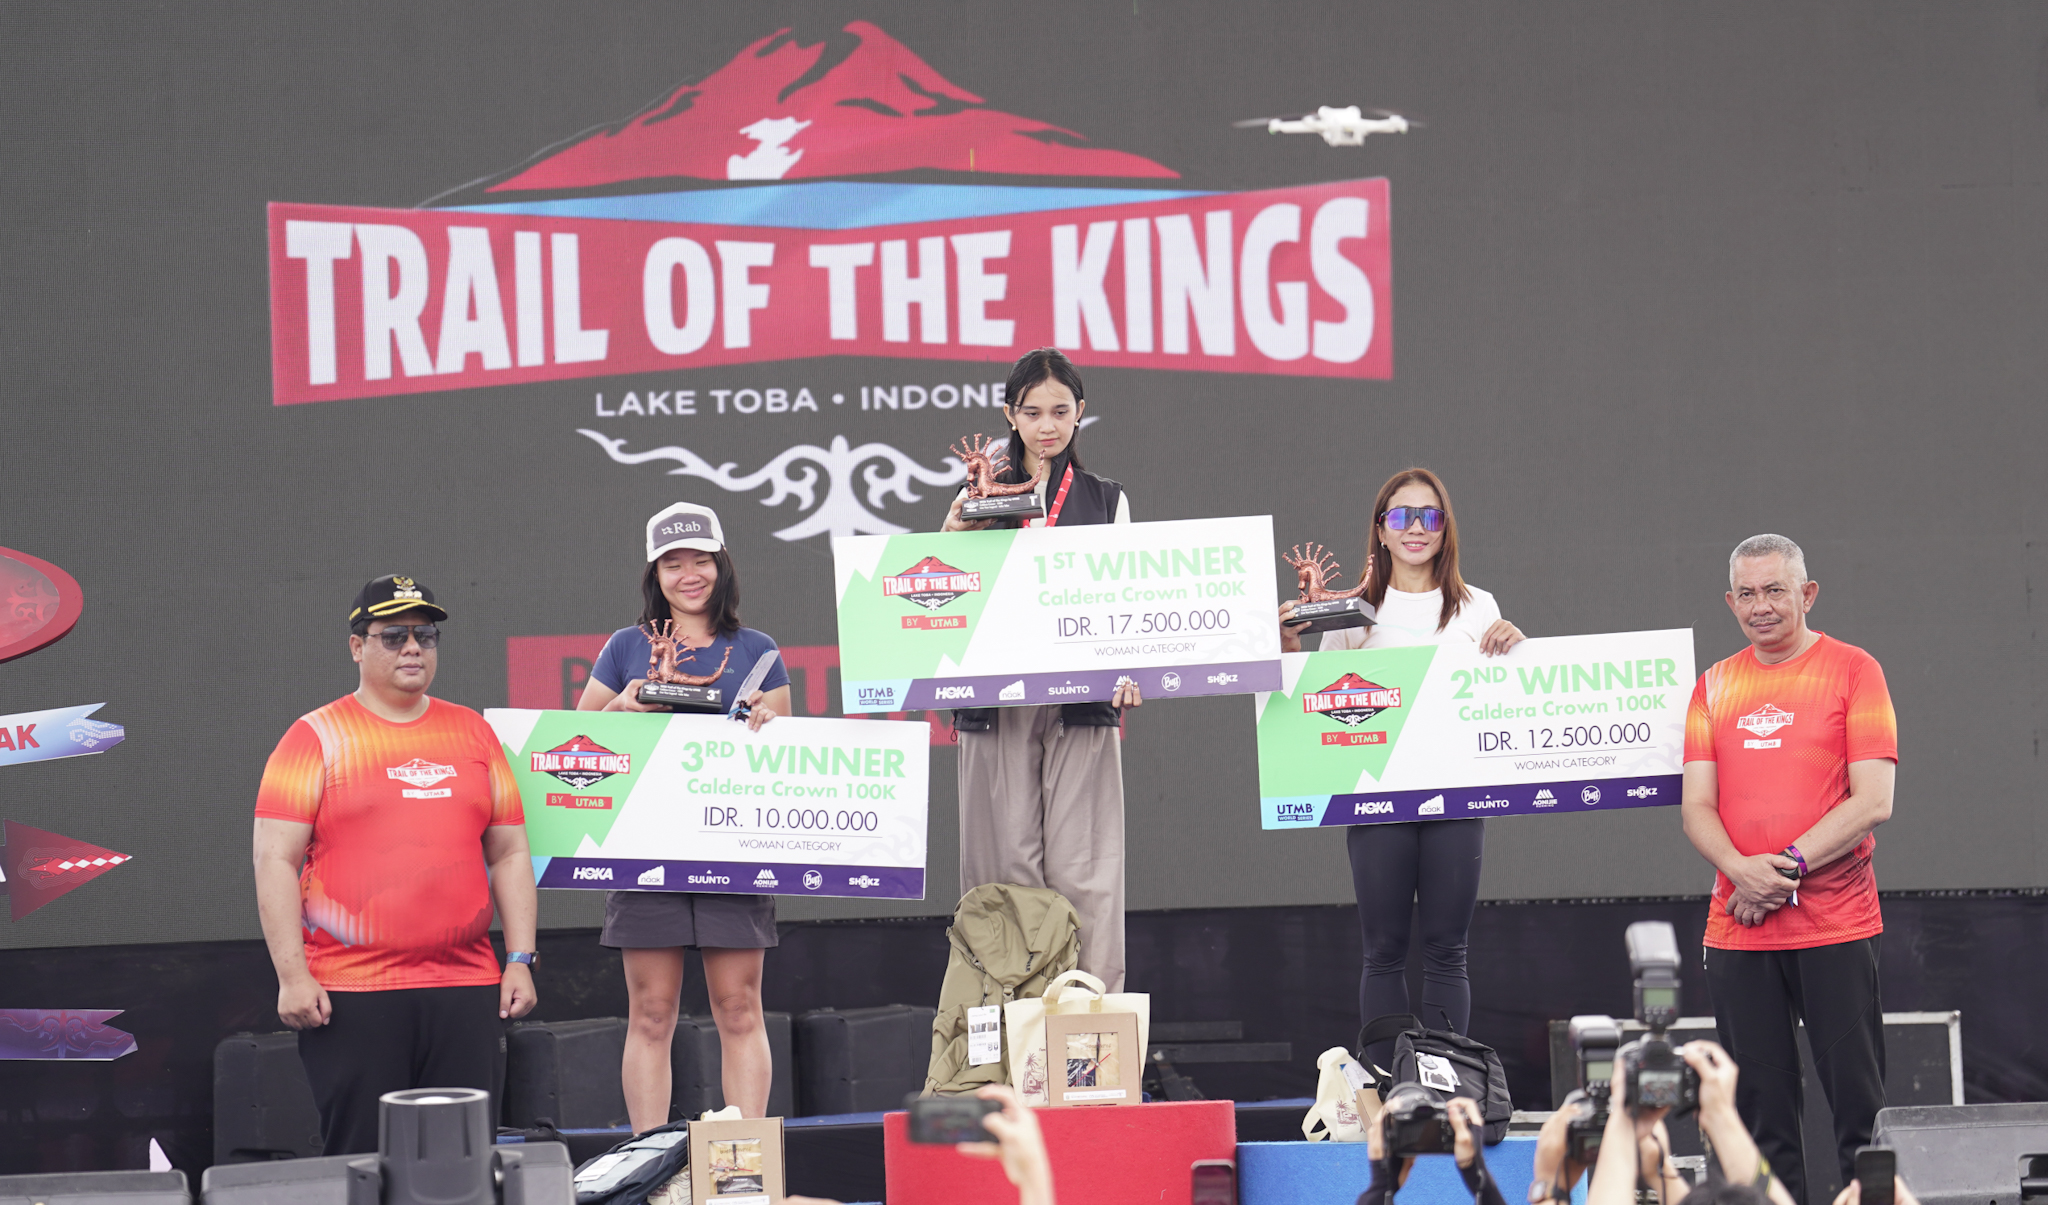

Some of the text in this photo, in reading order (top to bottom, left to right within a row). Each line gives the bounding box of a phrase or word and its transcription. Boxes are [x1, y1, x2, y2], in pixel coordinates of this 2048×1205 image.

[286, 196, 1374, 386] TRAIL OF THE KINGS
[595, 383, 1007, 417] LAKE TOBA INDONE
[673, 521, 701, 534] Rab
[1084, 546, 1247, 581] WINNER
[884, 573, 980, 595] TRAIL OF THE KINGS
[1038, 580, 1246, 606] Caldera Crown 100K
[907, 618, 959, 627] BY UTMB
[1058, 609, 1230, 637] IDR. 17.500.000
[1094, 643, 1196, 656] WOMAN CATEGORY
[1208, 674, 1238, 684] SHOKZ
[1517, 658, 1679, 695] WINNER
[859, 688, 893, 698] UTMB
[935, 686, 974, 699] HOKA
[1048, 686, 1090, 695] SUUNTO
[1304, 689, 1400, 711] TRAIL OF THE KINGS
[1459, 694, 1667, 721] Caldera Crown 100K
[1739, 718, 1754, 727] TRAIL
[1776, 714, 1792, 723] KINGS
[1350, 734, 1379, 744] UTMB
[1478, 722, 1650, 752] IDR. 12.500.000
[532, 753, 629, 773] TRAIL OF THE KINGS
[745, 744, 906, 778] WINNER
[1514, 756, 1616, 770] WOMAN CATEGORY
[687, 778, 896, 800] Caldera Crown 100K
[1627, 788, 1657, 797] SHOKZ
[576, 798, 604, 807] UTMB
[1277, 804, 1312, 814] UTMB
[1354, 801, 1394, 815] HOKA
[1468, 800, 1509, 809] SUUNTO
[704, 806, 877, 831] IDR. 10.000.000
[739, 839, 841, 851] WOMAN CATEGORY
[573, 867, 613, 880] HOKA
[688, 875, 730, 884] SUUNTO
[849, 877, 880, 886] SHOKZ
